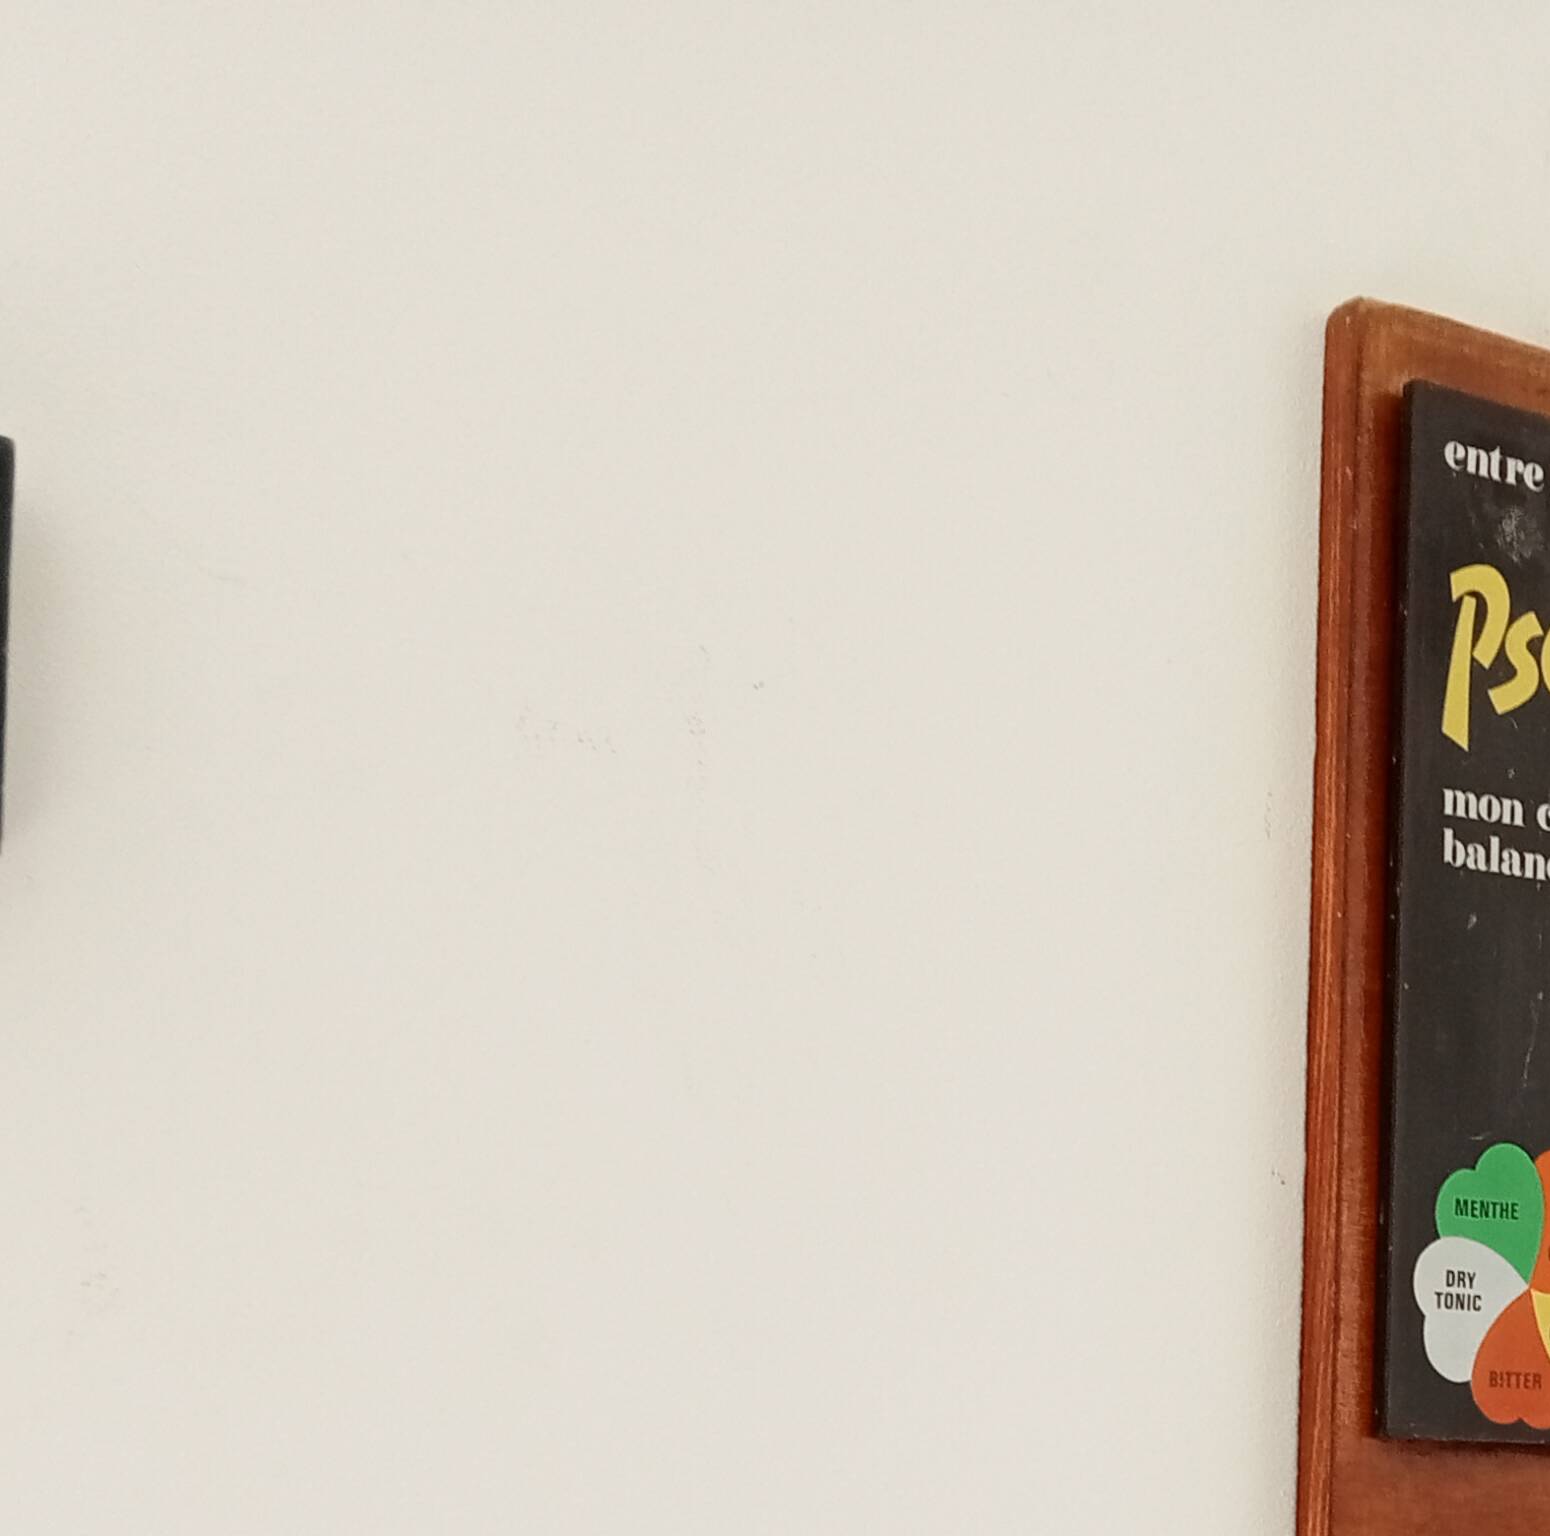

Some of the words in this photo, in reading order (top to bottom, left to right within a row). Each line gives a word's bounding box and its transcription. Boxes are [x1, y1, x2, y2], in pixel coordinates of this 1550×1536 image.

[1444, 439, 1545, 492] entre
[1442, 787, 1525, 828] mon
[1454, 1198, 1520, 1221] MENTHE
[1445, 1269, 1477, 1290] DRY
[1434, 1291, 1483, 1313] TONIC
[1488, 1370, 1543, 1390] BITTER
